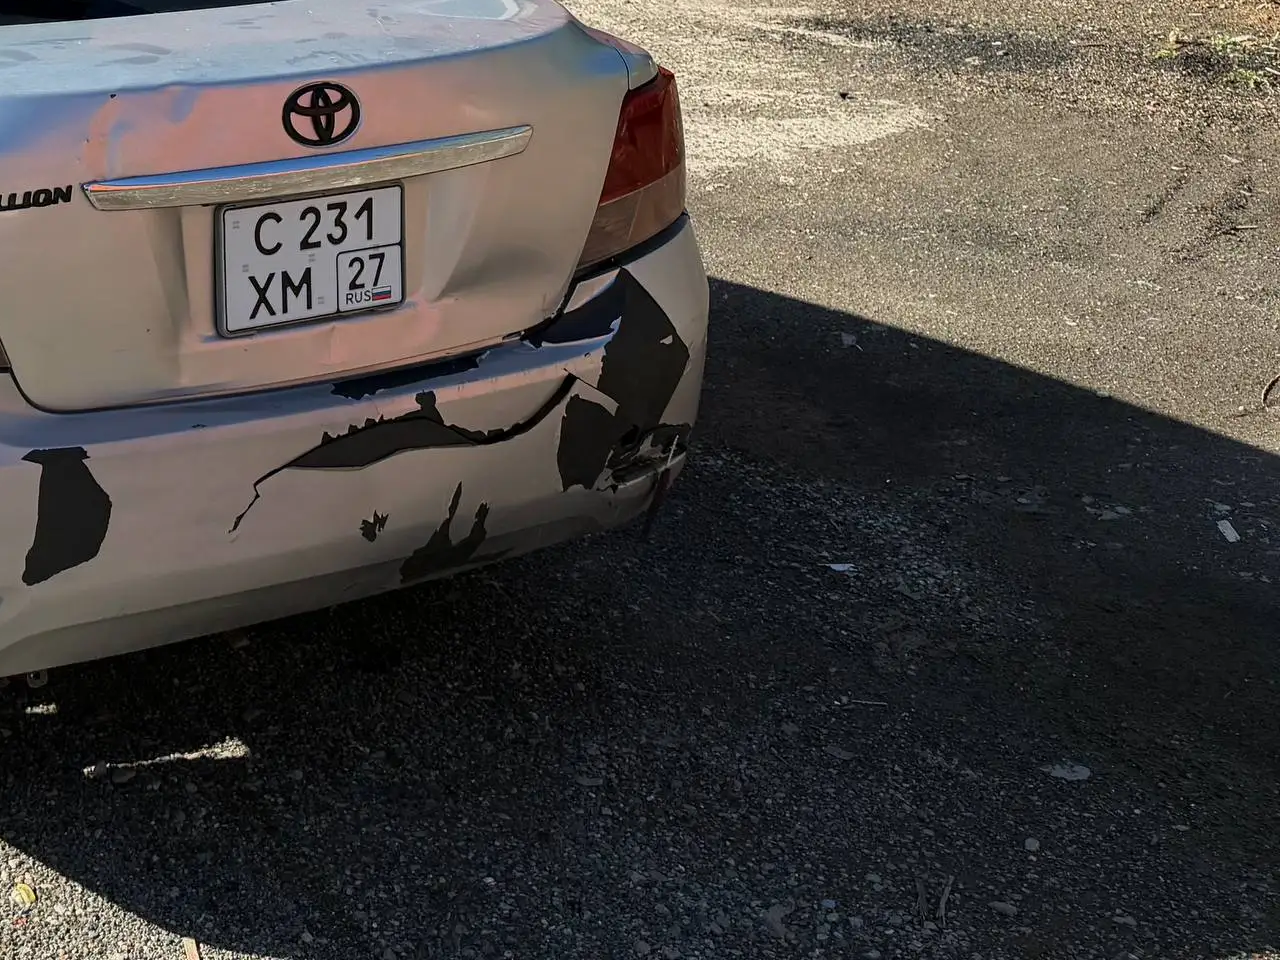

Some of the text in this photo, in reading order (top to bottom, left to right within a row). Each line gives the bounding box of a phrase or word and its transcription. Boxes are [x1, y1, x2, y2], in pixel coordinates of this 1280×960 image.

[254, 197, 373, 256] С 231
[247, 252, 386, 320] ХМ 27
[346, 290, 372, 305] RUS
